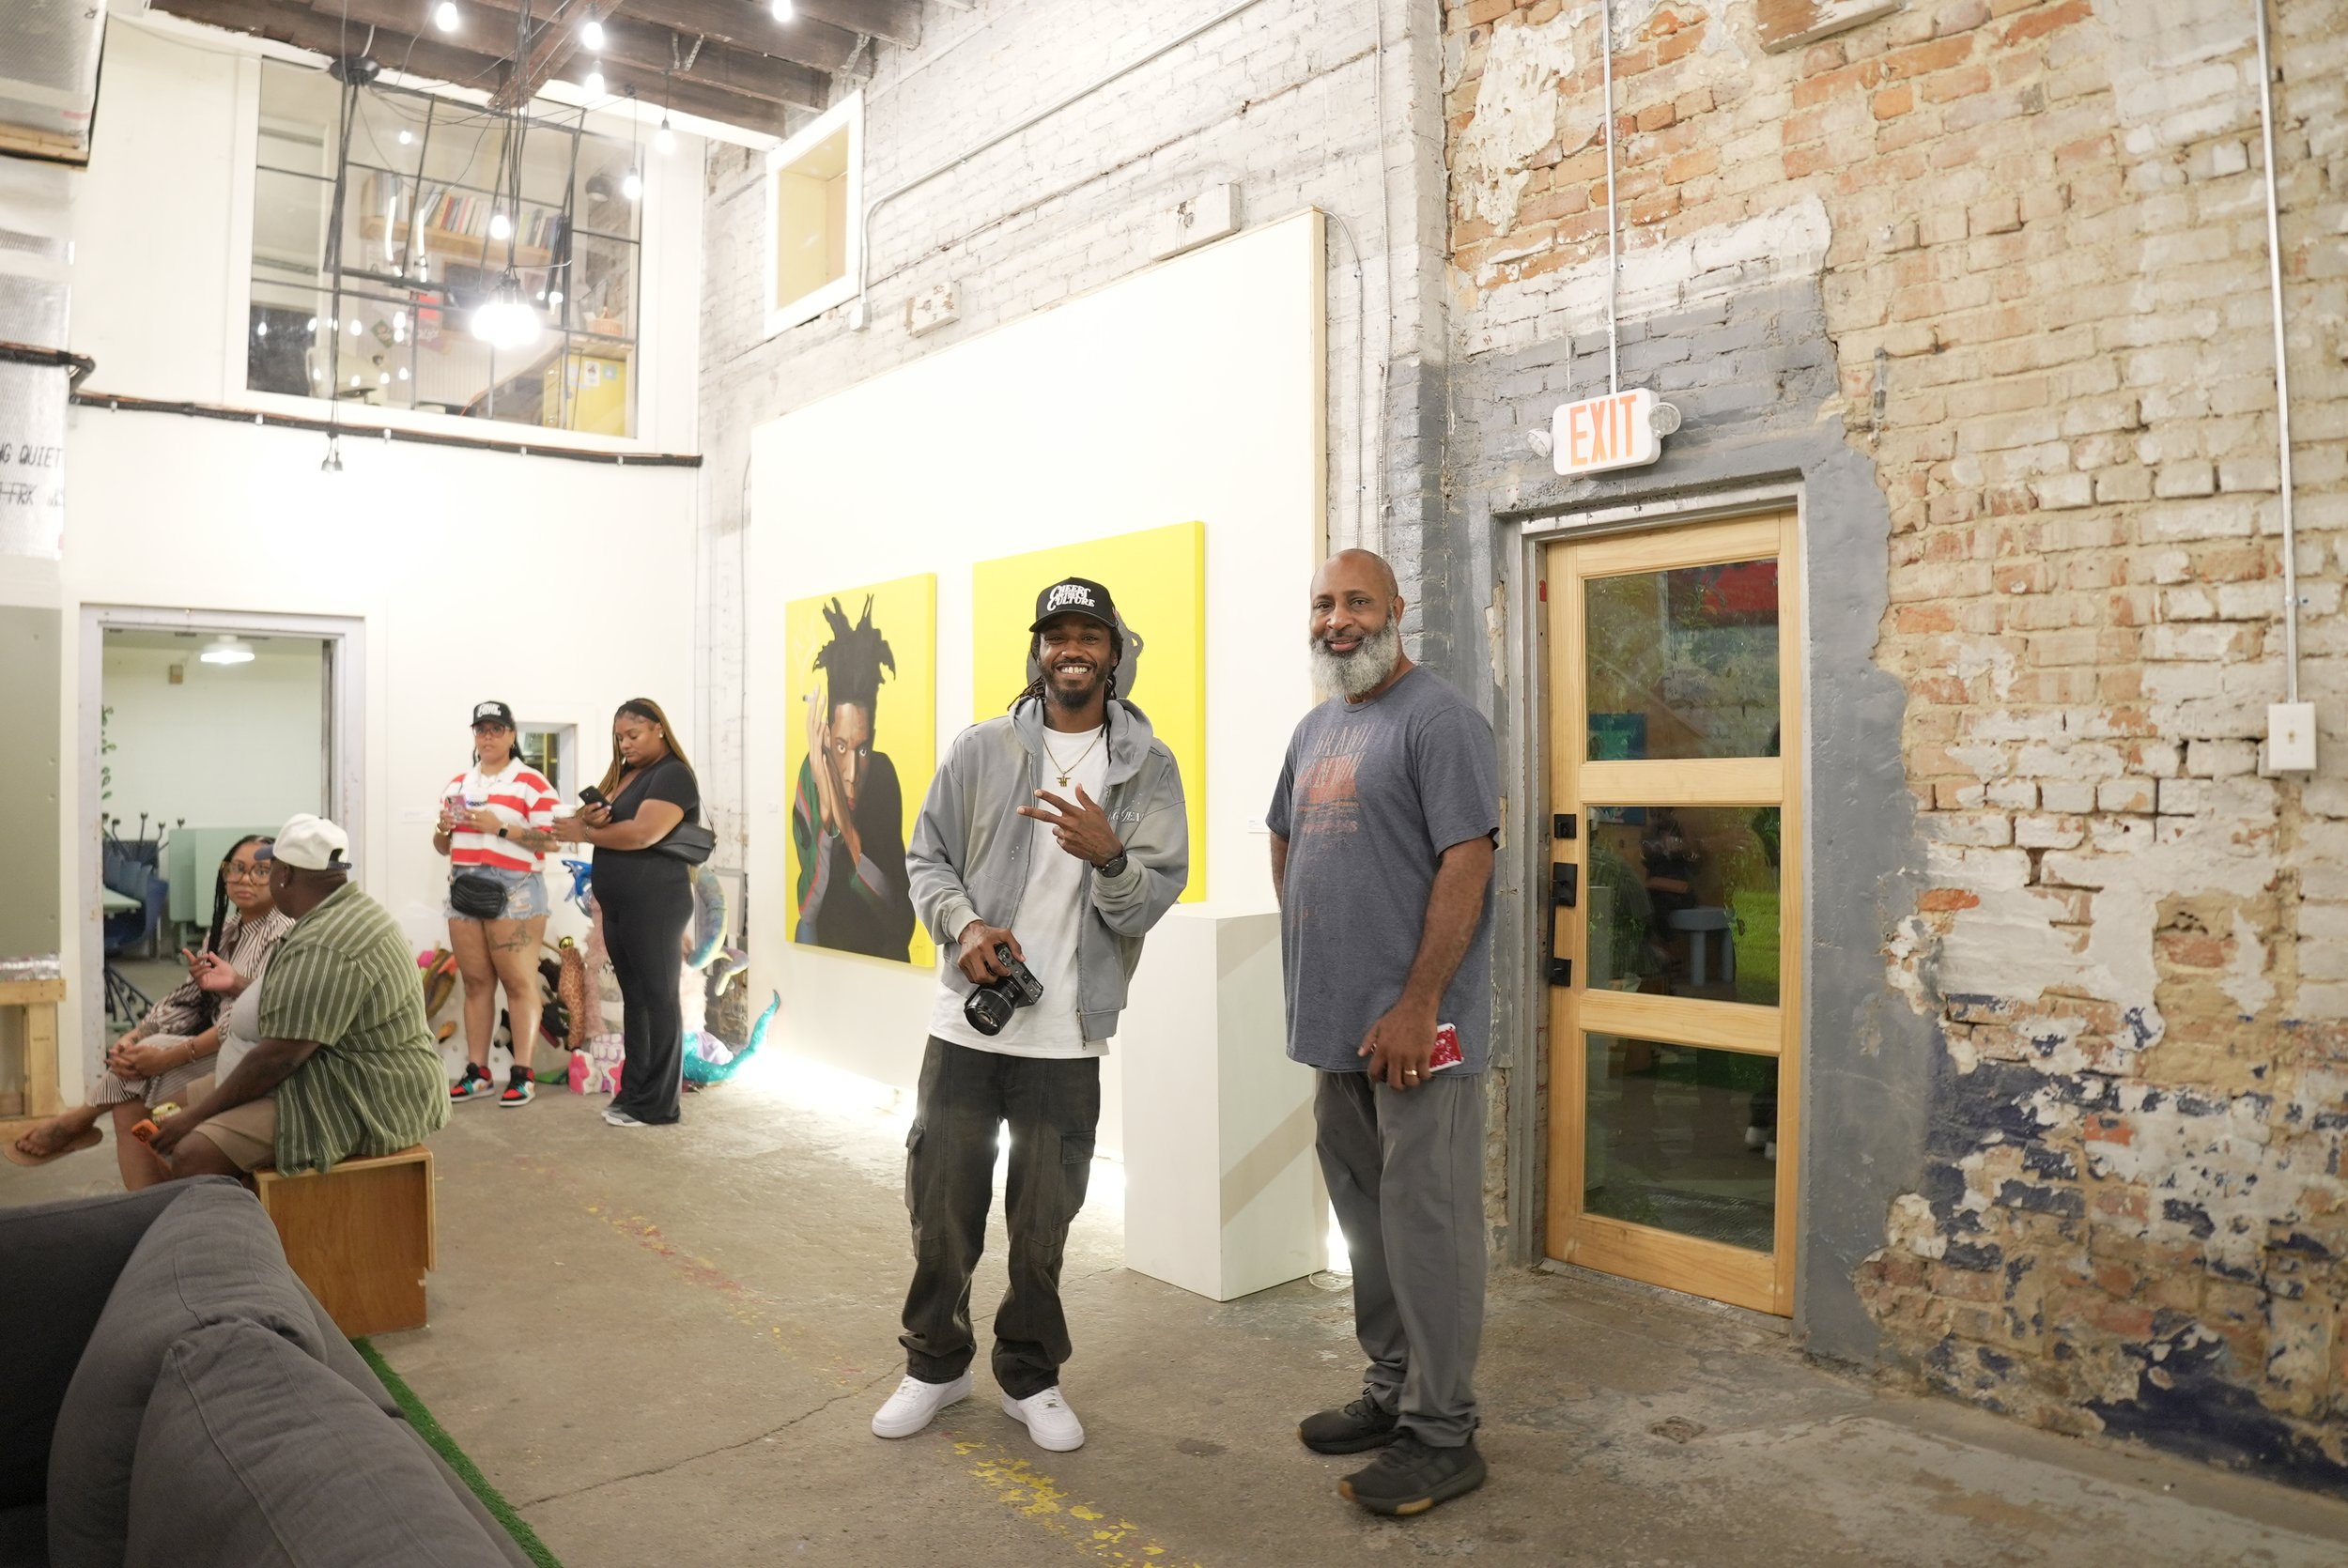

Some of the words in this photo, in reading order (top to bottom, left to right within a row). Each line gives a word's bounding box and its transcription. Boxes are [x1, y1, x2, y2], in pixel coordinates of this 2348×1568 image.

[1569, 394, 1637, 467] EXIT
[19, 444, 64, 468] QUIET
[1046, 592, 1096, 611] CULTURE
[1049, 584, 1091, 599] CHEERS
